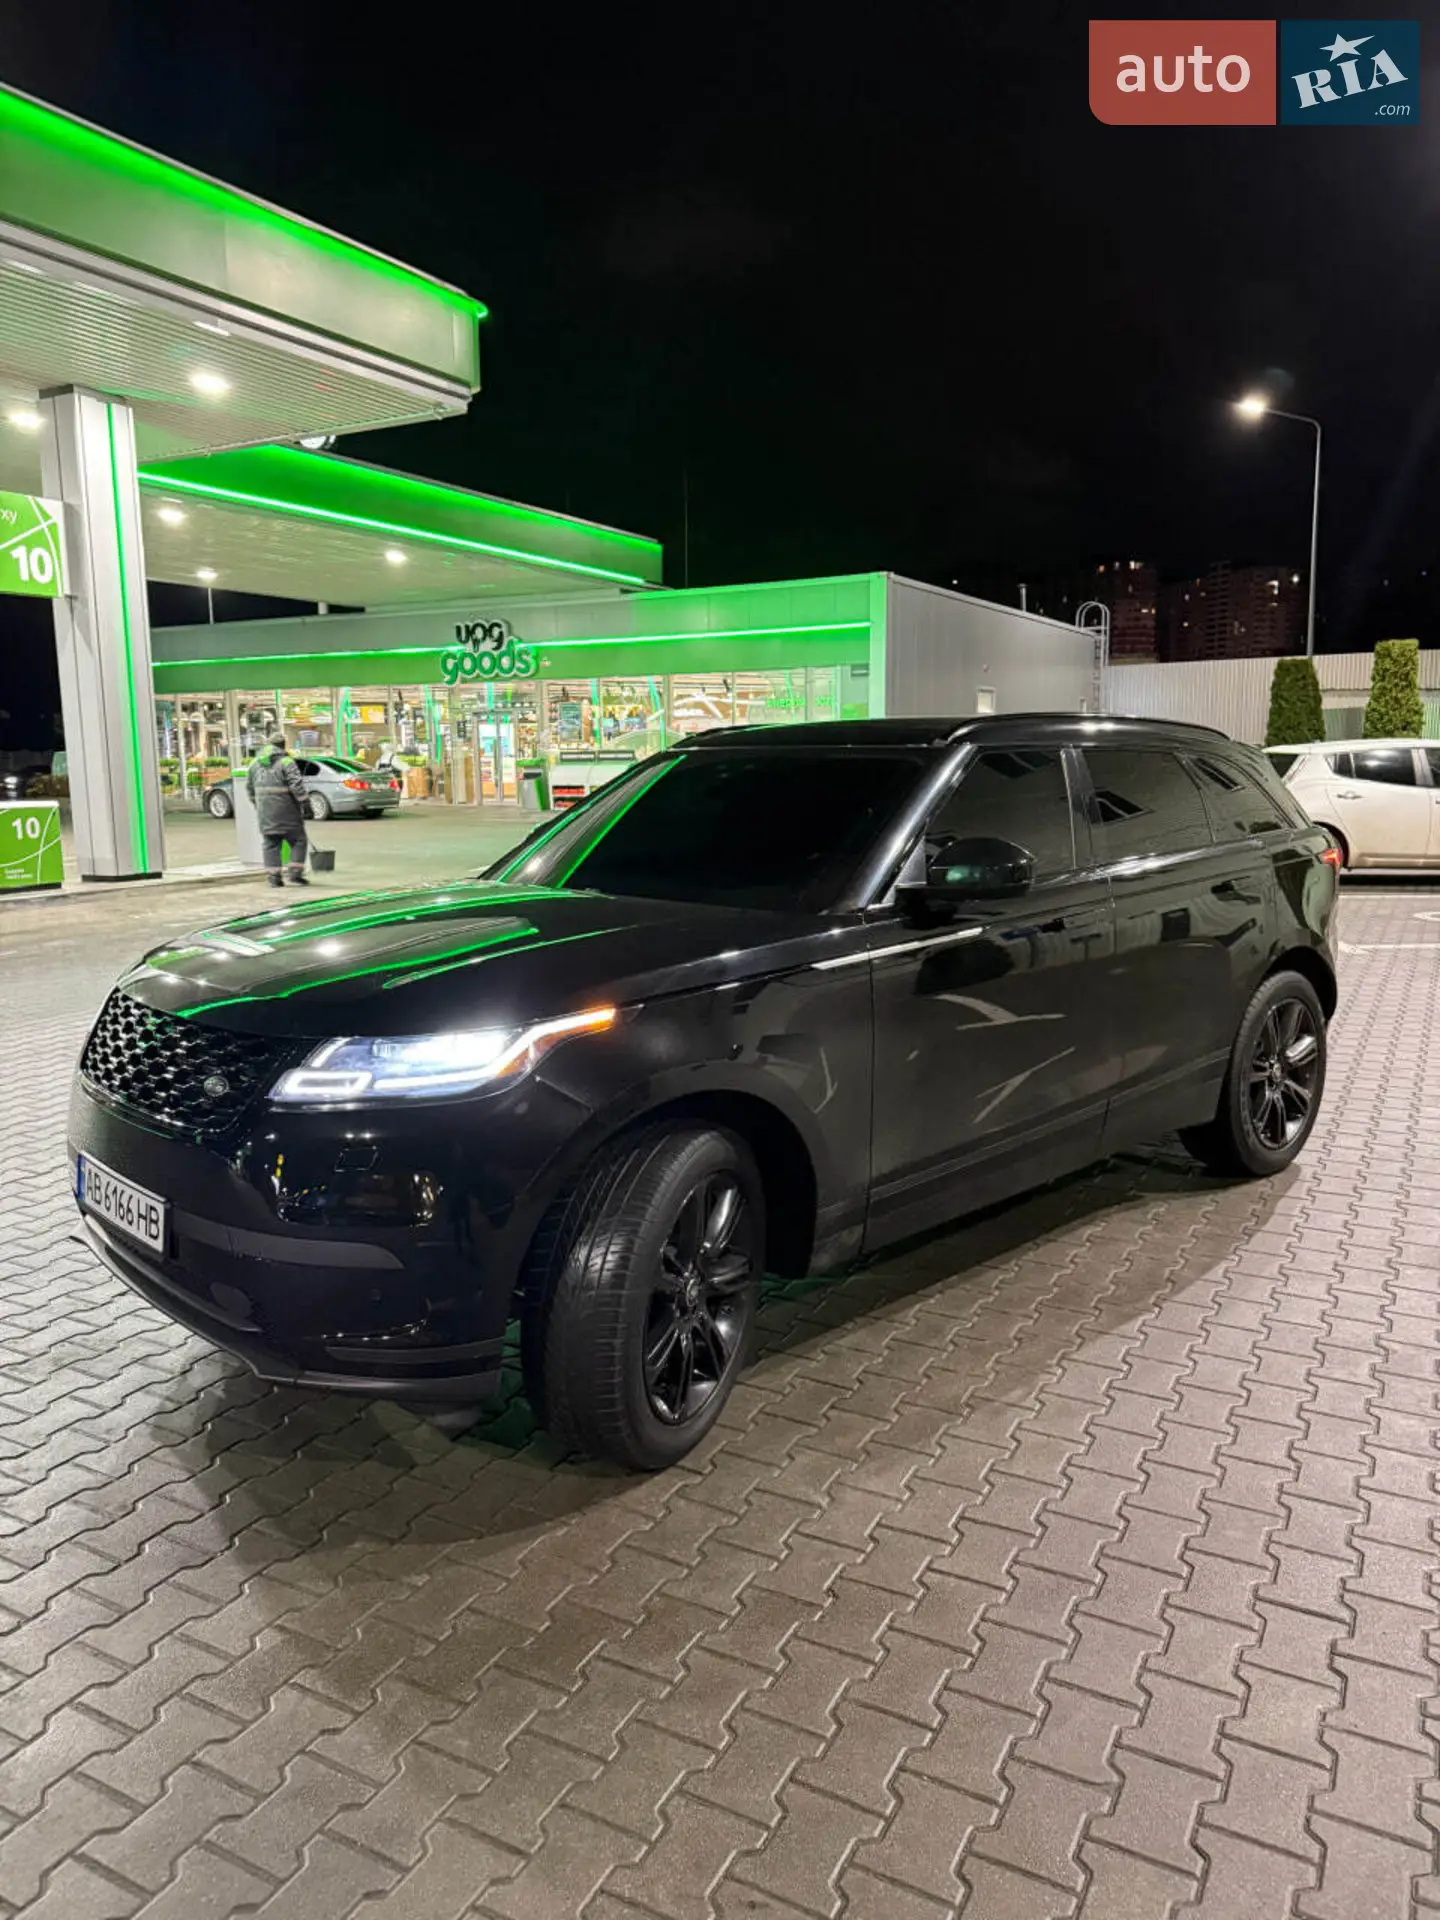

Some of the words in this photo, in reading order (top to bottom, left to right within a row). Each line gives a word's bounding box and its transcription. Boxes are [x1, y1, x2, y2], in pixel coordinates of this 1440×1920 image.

[10, 545, 53, 584] 10
[455, 621, 504, 653] upg
[441, 638, 531, 685] goods
[12, 816, 40, 840] 10
[104, 1181, 134, 1226] 6166
[137, 1197, 160, 1240] HB
